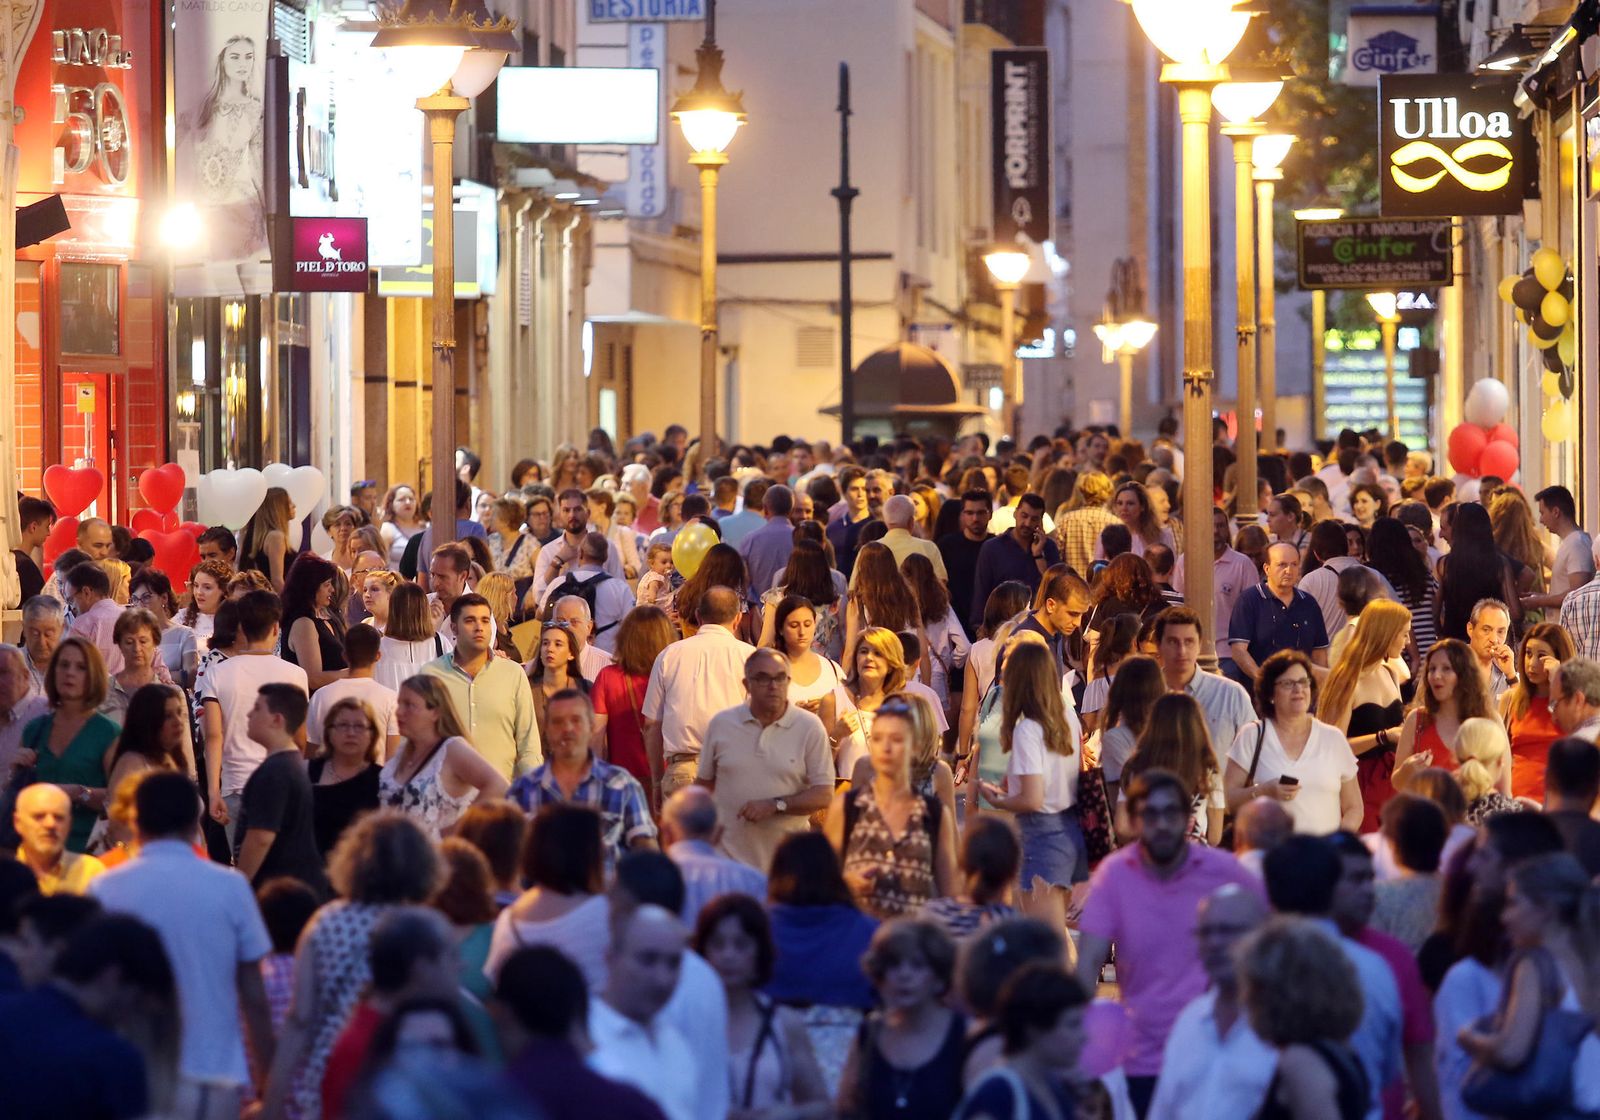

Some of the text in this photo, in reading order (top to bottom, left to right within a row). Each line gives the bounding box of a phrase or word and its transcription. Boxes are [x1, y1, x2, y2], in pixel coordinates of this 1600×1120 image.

[181, 0, 264, 13] MATILDE CANO
[1389, 97, 1513, 139] Ulloa
[50, 82, 132, 186] 50
[296, 261, 325, 273] PIEL
[335, 261, 366, 273] TORO
